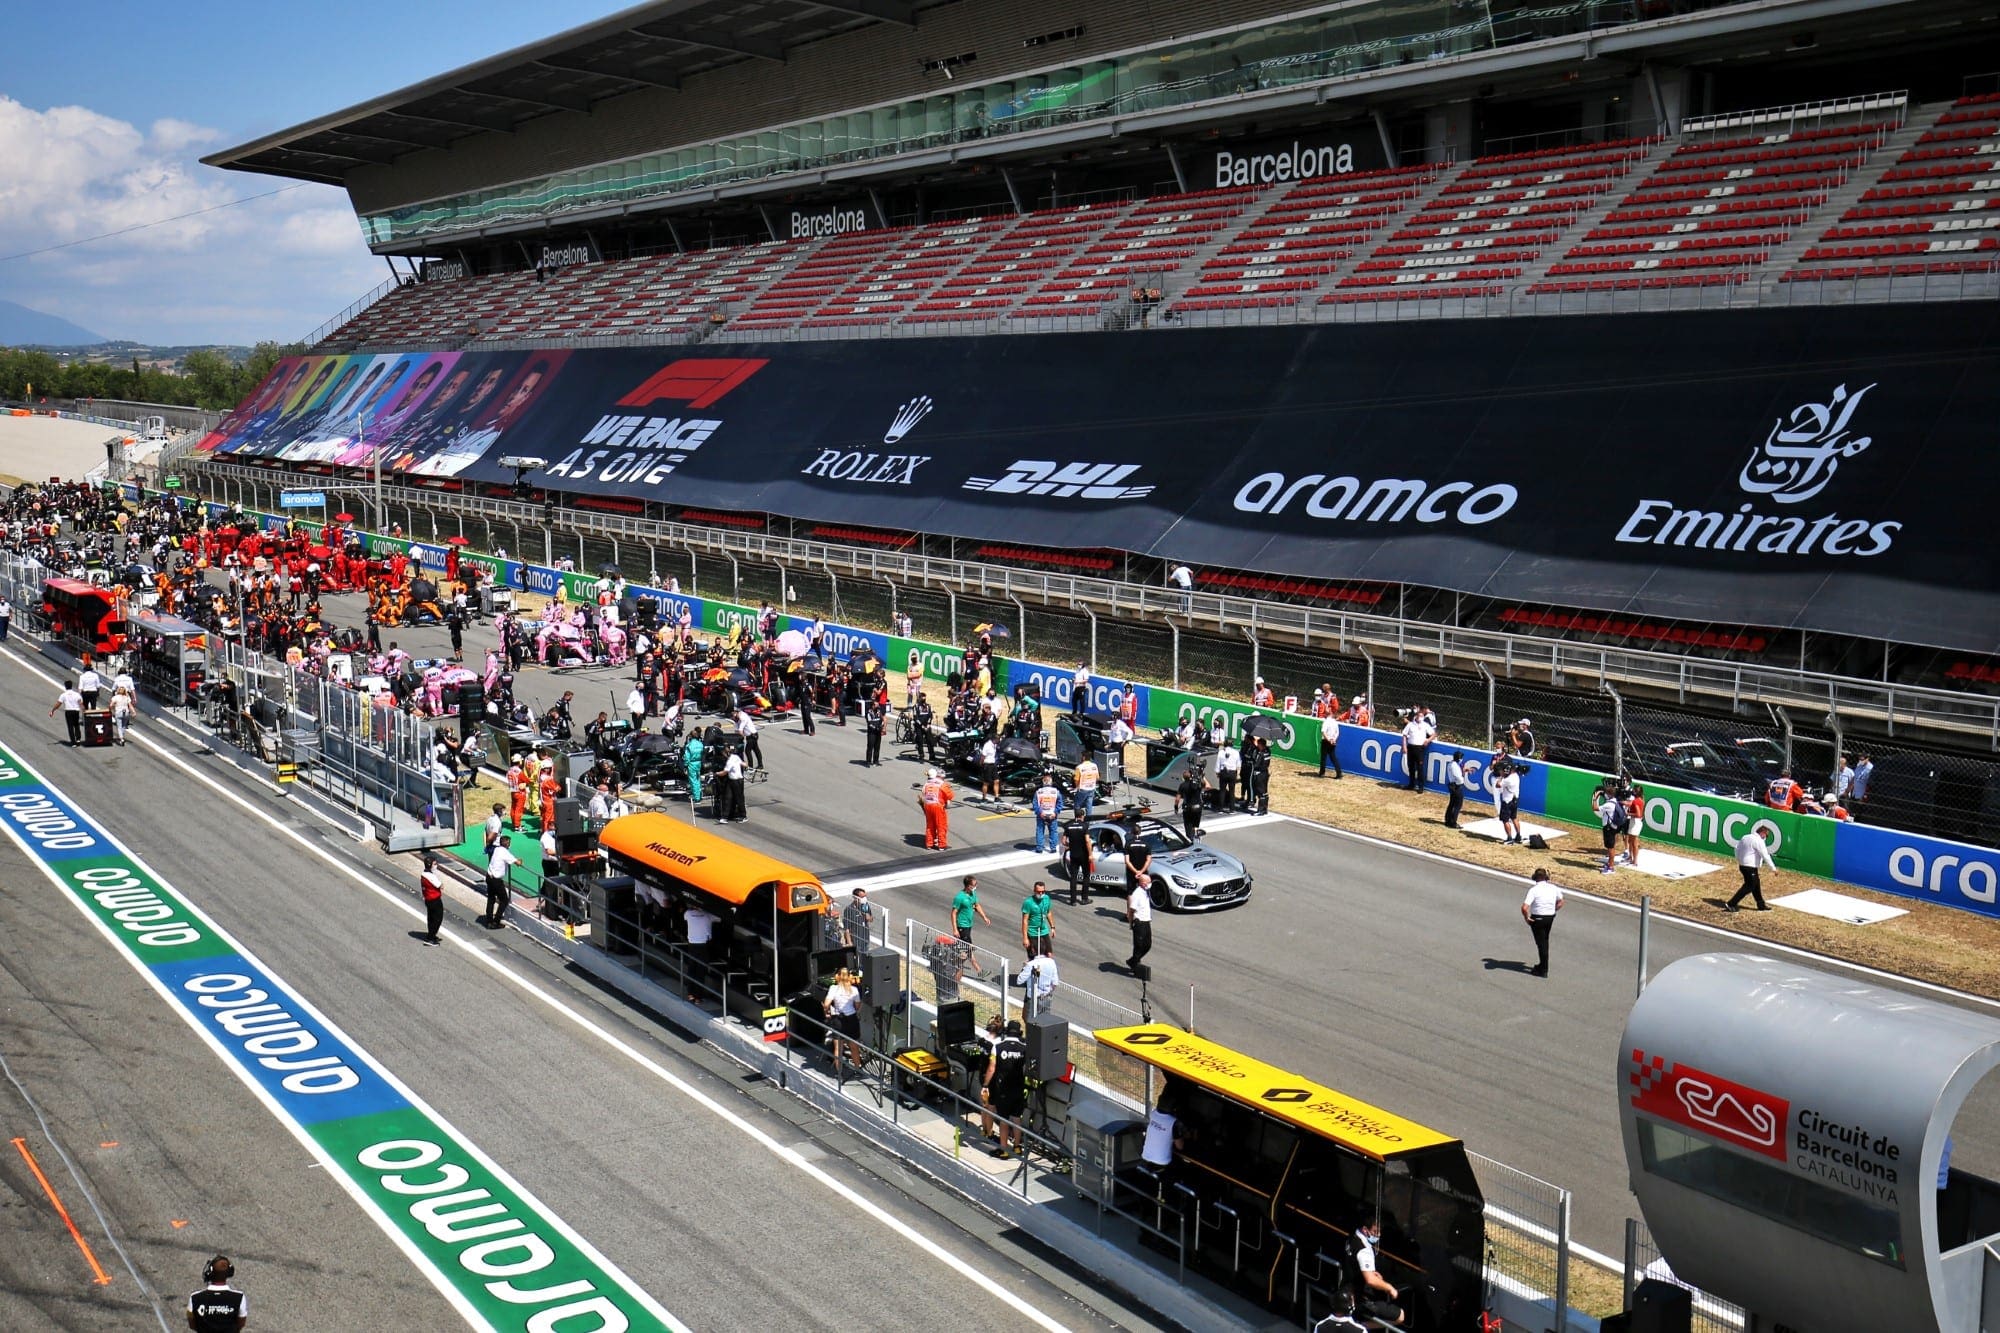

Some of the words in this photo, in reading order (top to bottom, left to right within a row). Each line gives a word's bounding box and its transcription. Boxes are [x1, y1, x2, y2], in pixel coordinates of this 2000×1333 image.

[1216, 141, 1353, 188] Barcelona
[791, 206, 866, 238] Barcelona
[426, 260, 463, 281] Barcelona
[543, 242, 589, 267] Barcelona
[546, 448, 607, 478] AS
[600, 452, 688, 485] ONE
[801, 449, 932, 485] ROLEX
[991, 460, 1143, 499] DHL
[284, 494, 320, 504] aramco
[1233, 472, 1518, 525] aramco
[1615, 499, 1903, 556] Emirates
[422, 549, 446, 567] amco
[1286, 698, 1296, 711] F
[0, 793, 96, 849] aramco
[645, 842, 695, 867] McLaren
[74, 867, 201, 946] aramco
[184, 973, 361, 1094] aramco
[1334, 1114, 1403, 1142] WORLD
[1798, 1109, 1869, 1150] Circuit
[1873, 1135, 1900, 1161] de
[1797, 1131, 1898, 1185] Barcelona
[1796, 1155, 1899, 1206] CATALUNYA
[357, 1139, 631, 1333] aramco
